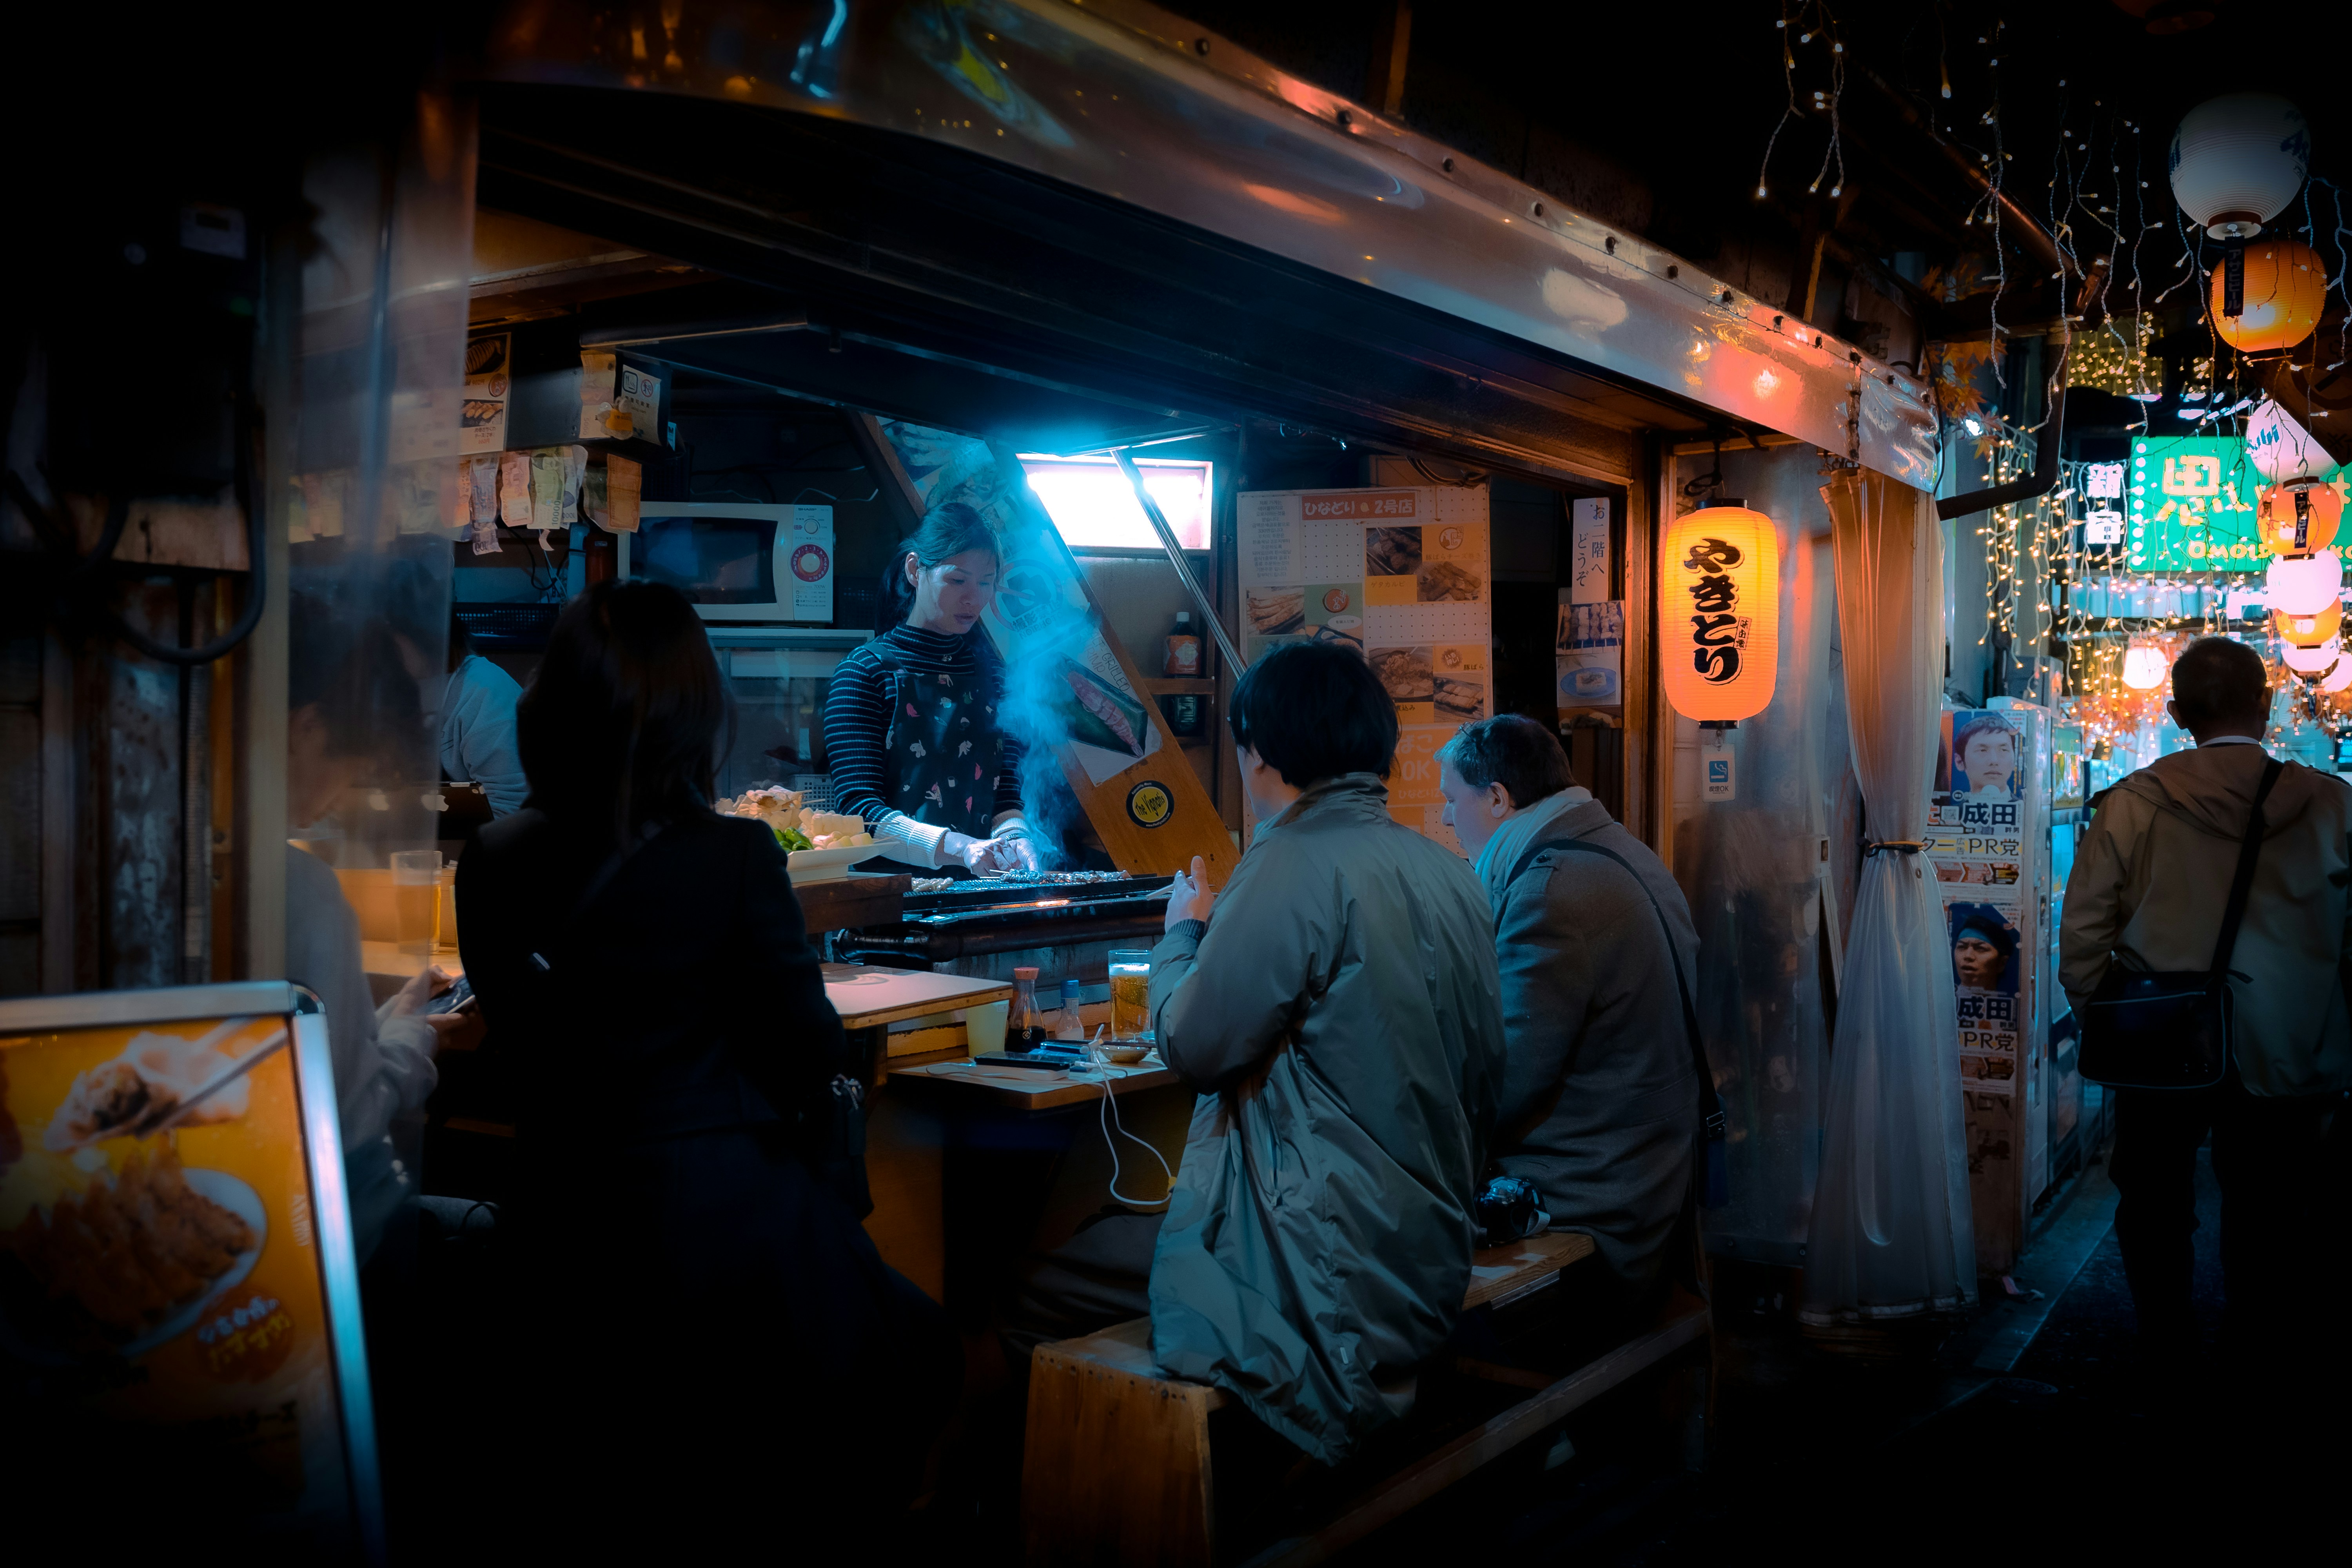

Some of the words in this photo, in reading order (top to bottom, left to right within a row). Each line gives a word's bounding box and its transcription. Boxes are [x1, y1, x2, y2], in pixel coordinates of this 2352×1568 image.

[2227, 249, 2242, 310] アサヒビール
[1304, 500, 1355, 516] ひなどり
[1374, 499, 1413, 514] 2号店
[1591, 504, 1605, 575] お二階へ
[2188, 541, 2270, 559] OMOID
[1576, 533, 1589, 587] どうぞ
[1684, 536, 1744, 686] やきとり
[1402, 760, 1431, 781] OK
[1135, 802, 1148, 815] The
[1963, 803, 2016, 826] 成田
[1958, 996, 2012, 1021] 成田
